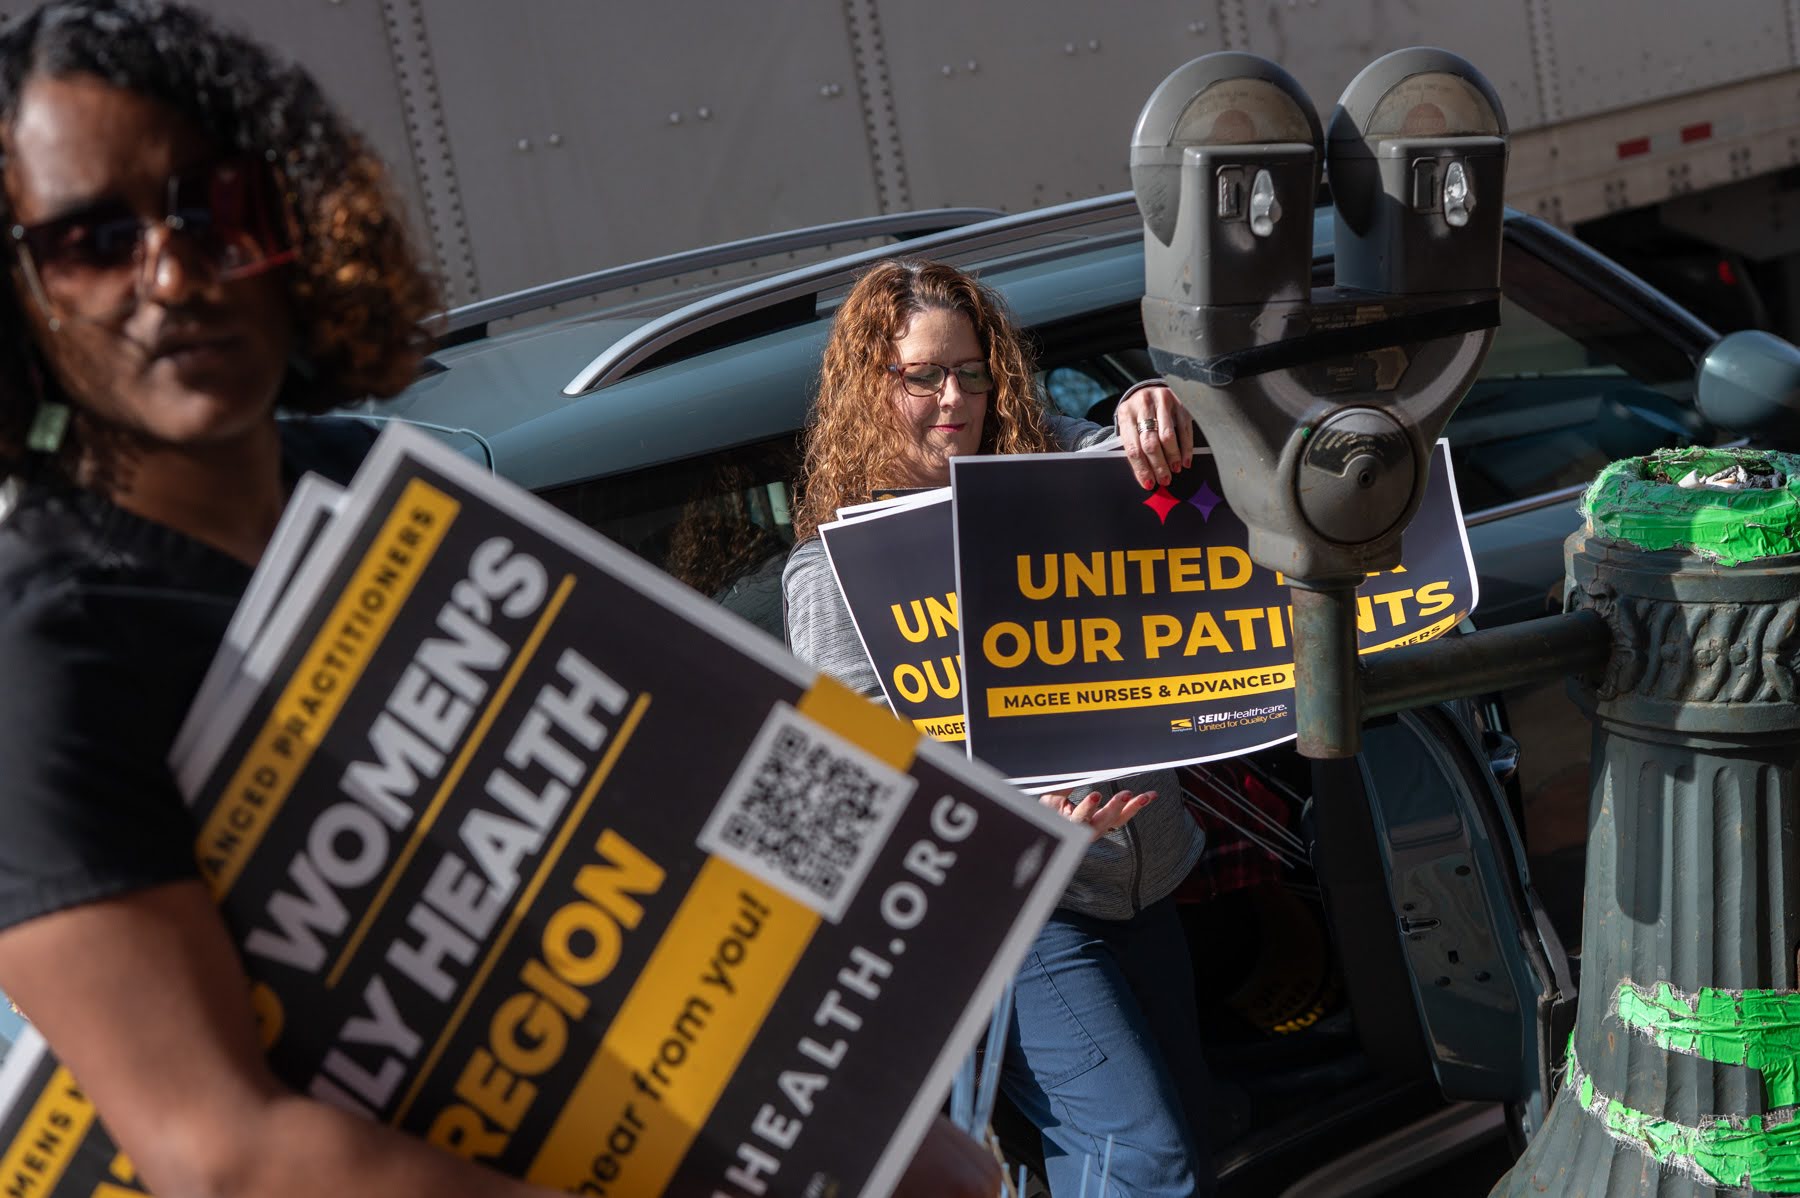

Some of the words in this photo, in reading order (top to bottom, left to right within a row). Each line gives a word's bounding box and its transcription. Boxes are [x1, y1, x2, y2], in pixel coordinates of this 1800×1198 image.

[272, 506, 436, 757] PRACTITIONERS
[893, 655, 963, 703] OU
[982, 617, 1124, 668] OUR
[1017, 545, 1253, 600] UNITED
[245, 536, 549, 973] WOMEN'S
[1004, 692, 1070, 708] MAGEE
[1077, 686, 1152, 704] NURSES
[1158, 685, 1171, 698] &
[1177, 672, 1286, 696] ADVANCED
[1199, 720, 1226, 732] United
[1227, 720, 1238, 728] for
[1240, 715, 1268, 725] Quality
[1269, 711, 1288, 720] Care
[386, 648, 630, 1001] HEALTH
[427, 829, 667, 1160] REGION
[631, 992, 715, 1101] from
[701, 888, 772, 995] you!
[711, 795, 979, 1198] HEALTH.ORG
